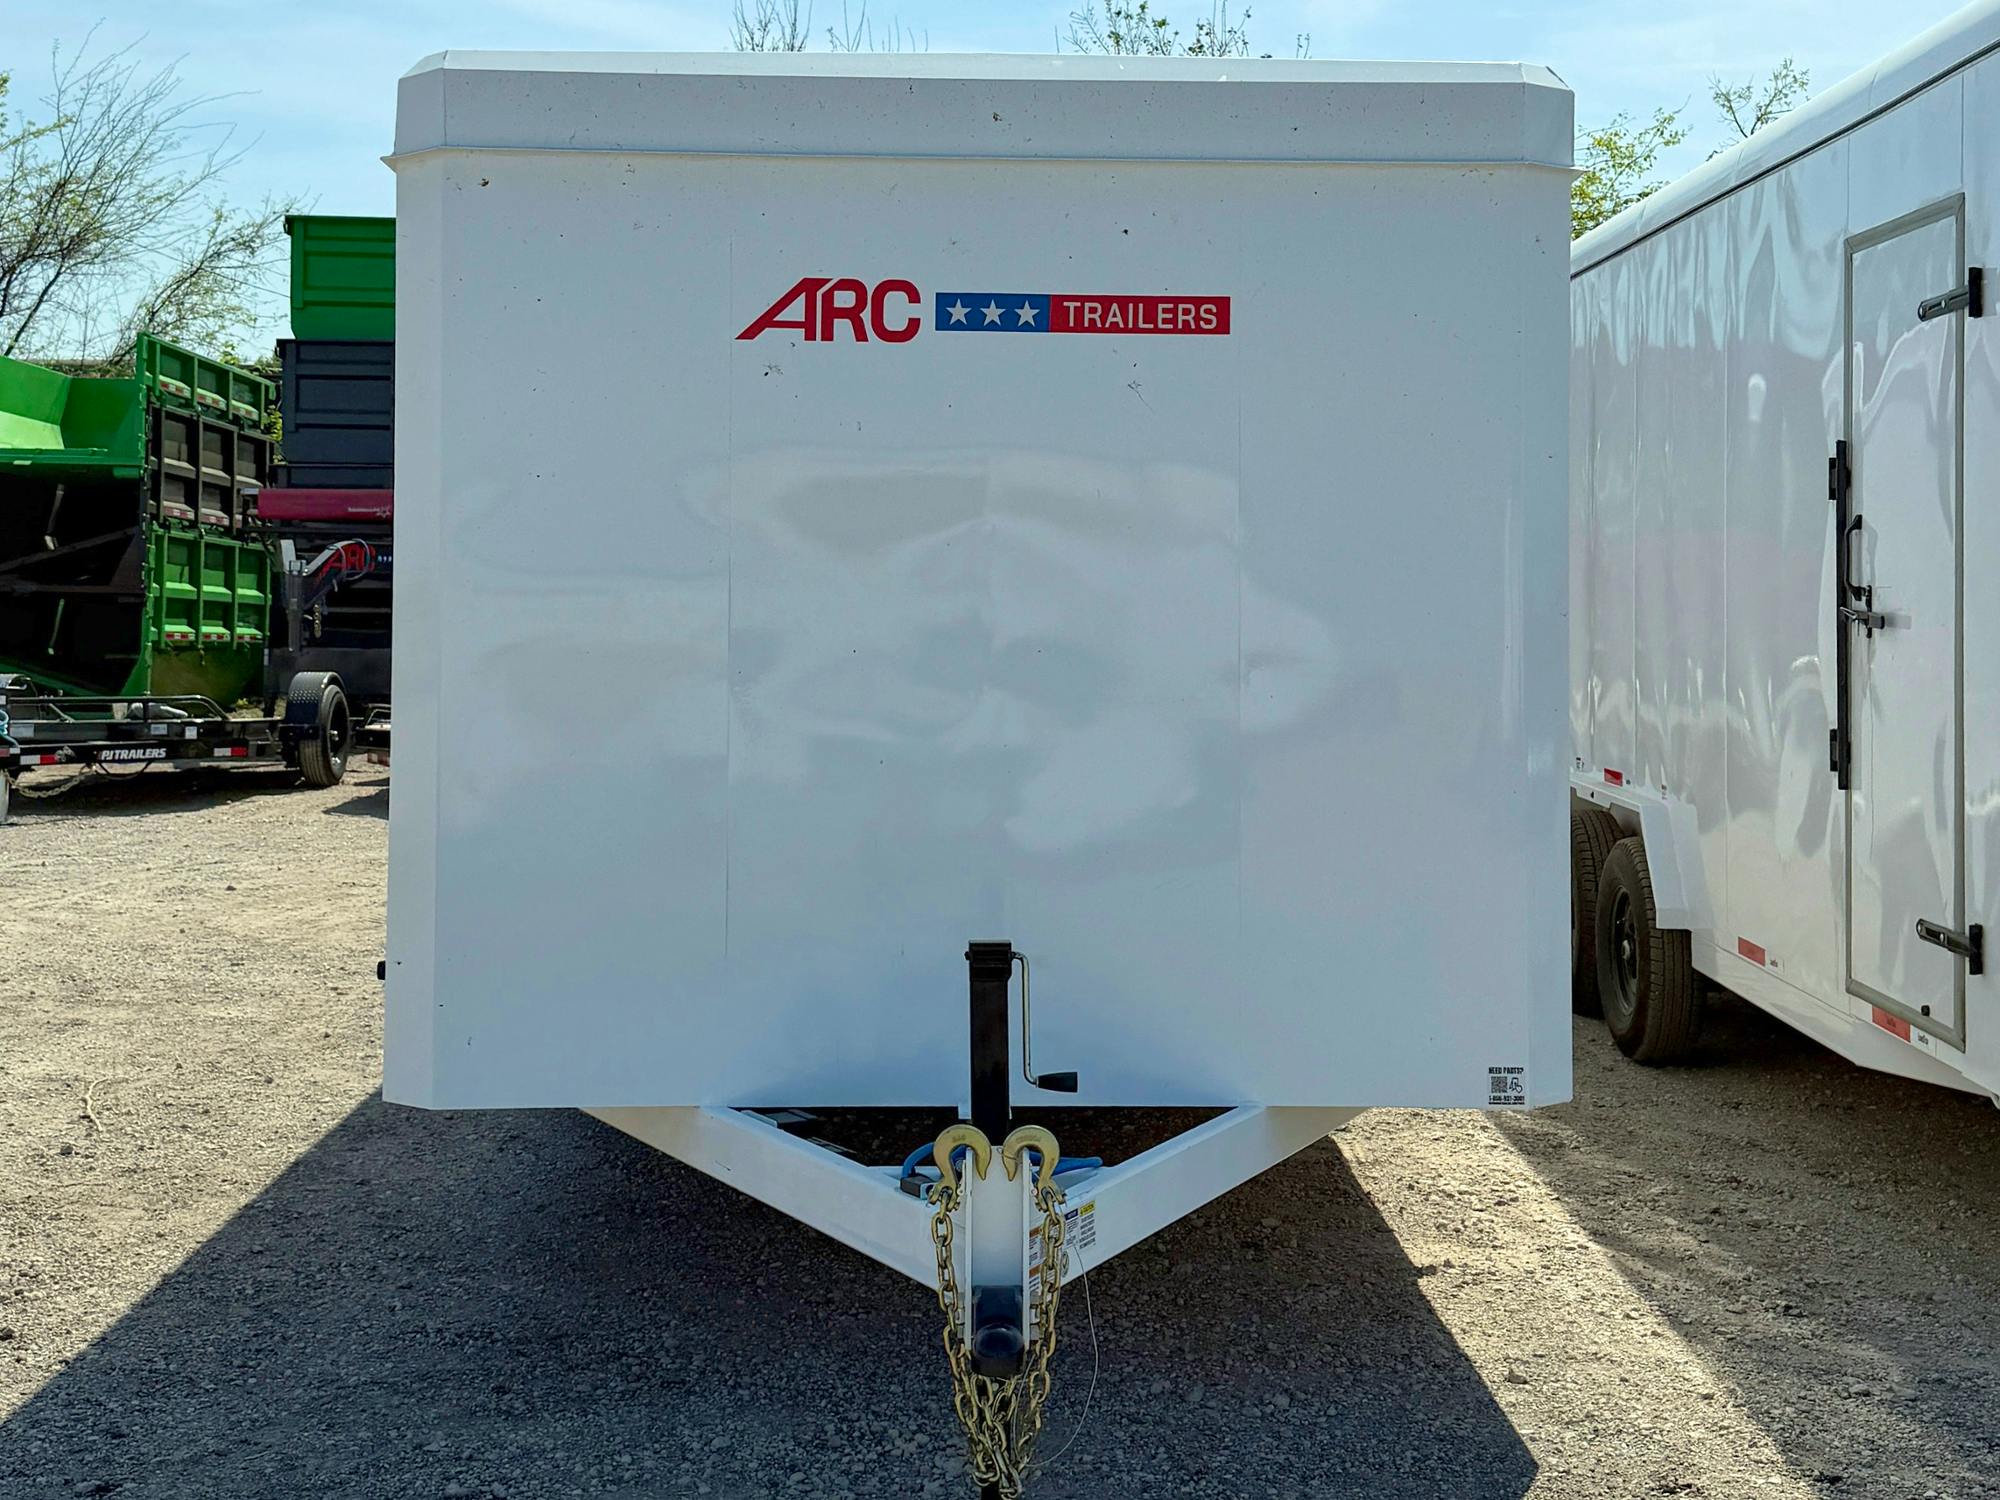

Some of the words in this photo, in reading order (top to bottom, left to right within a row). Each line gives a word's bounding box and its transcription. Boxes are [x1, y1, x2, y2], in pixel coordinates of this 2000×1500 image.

[735, 277, 922, 343] ARC
[1063, 300, 1217, 330] TRAILERS
[114, 748, 167, 760] TRAILERS
